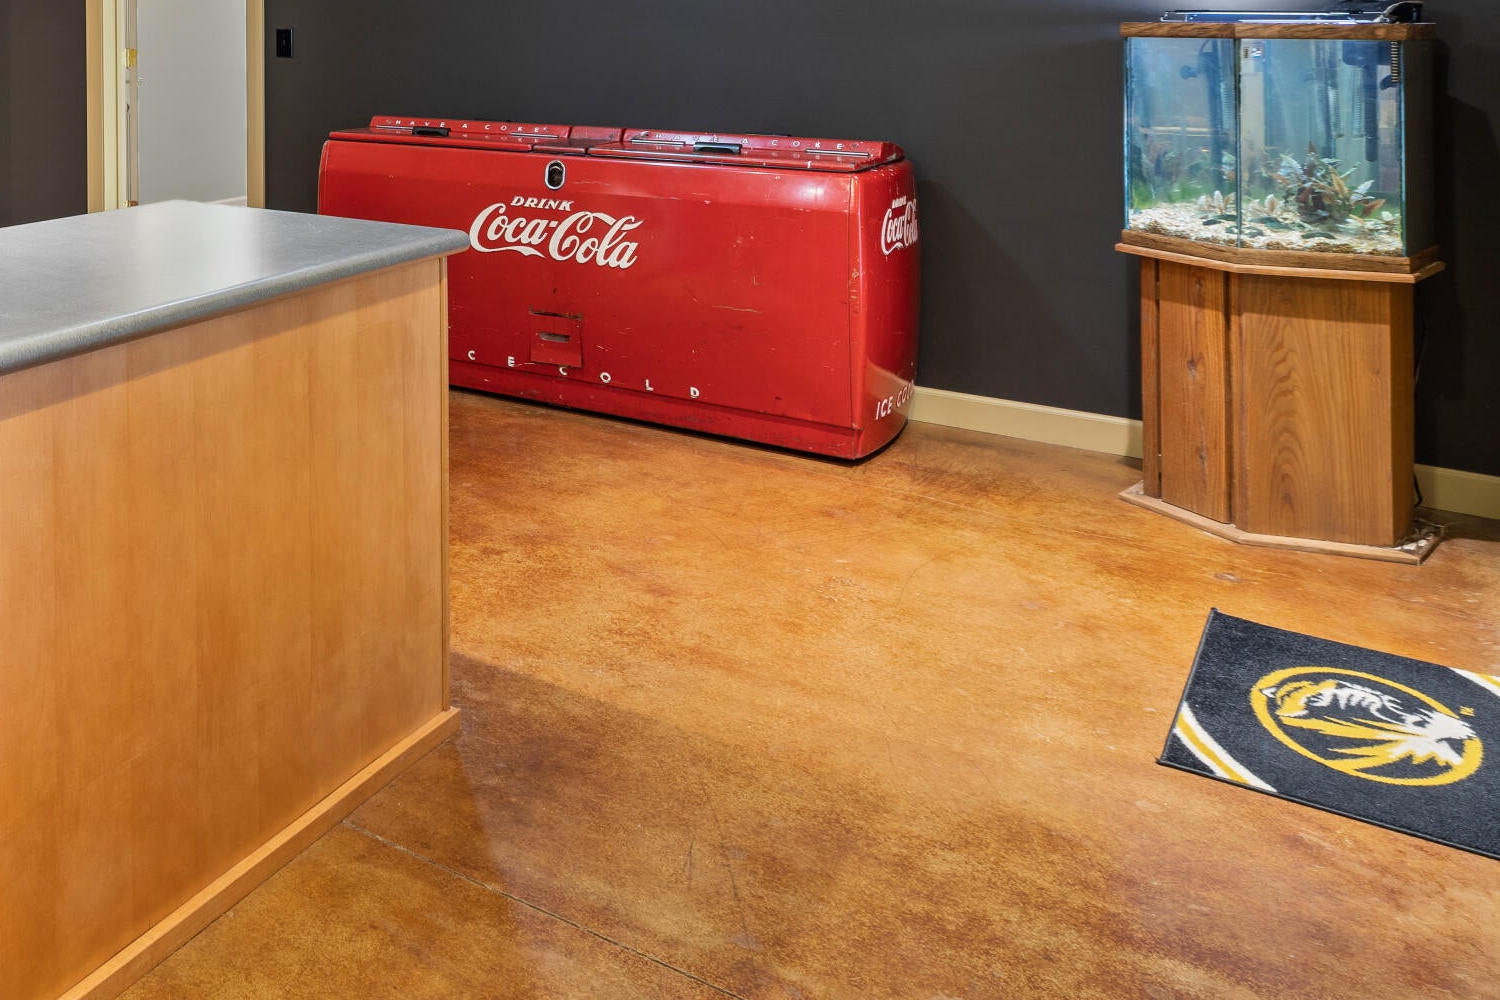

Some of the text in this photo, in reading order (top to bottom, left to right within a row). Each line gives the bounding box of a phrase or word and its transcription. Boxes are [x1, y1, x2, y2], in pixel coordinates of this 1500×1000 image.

[484, 124, 539, 132] COKE
[510, 196, 574, 212] DRINK
[469, 203, 644, 269] Coca-Cola
[559, 366, 700, 399] COLD
[875, 396, 893, 420] ICE
